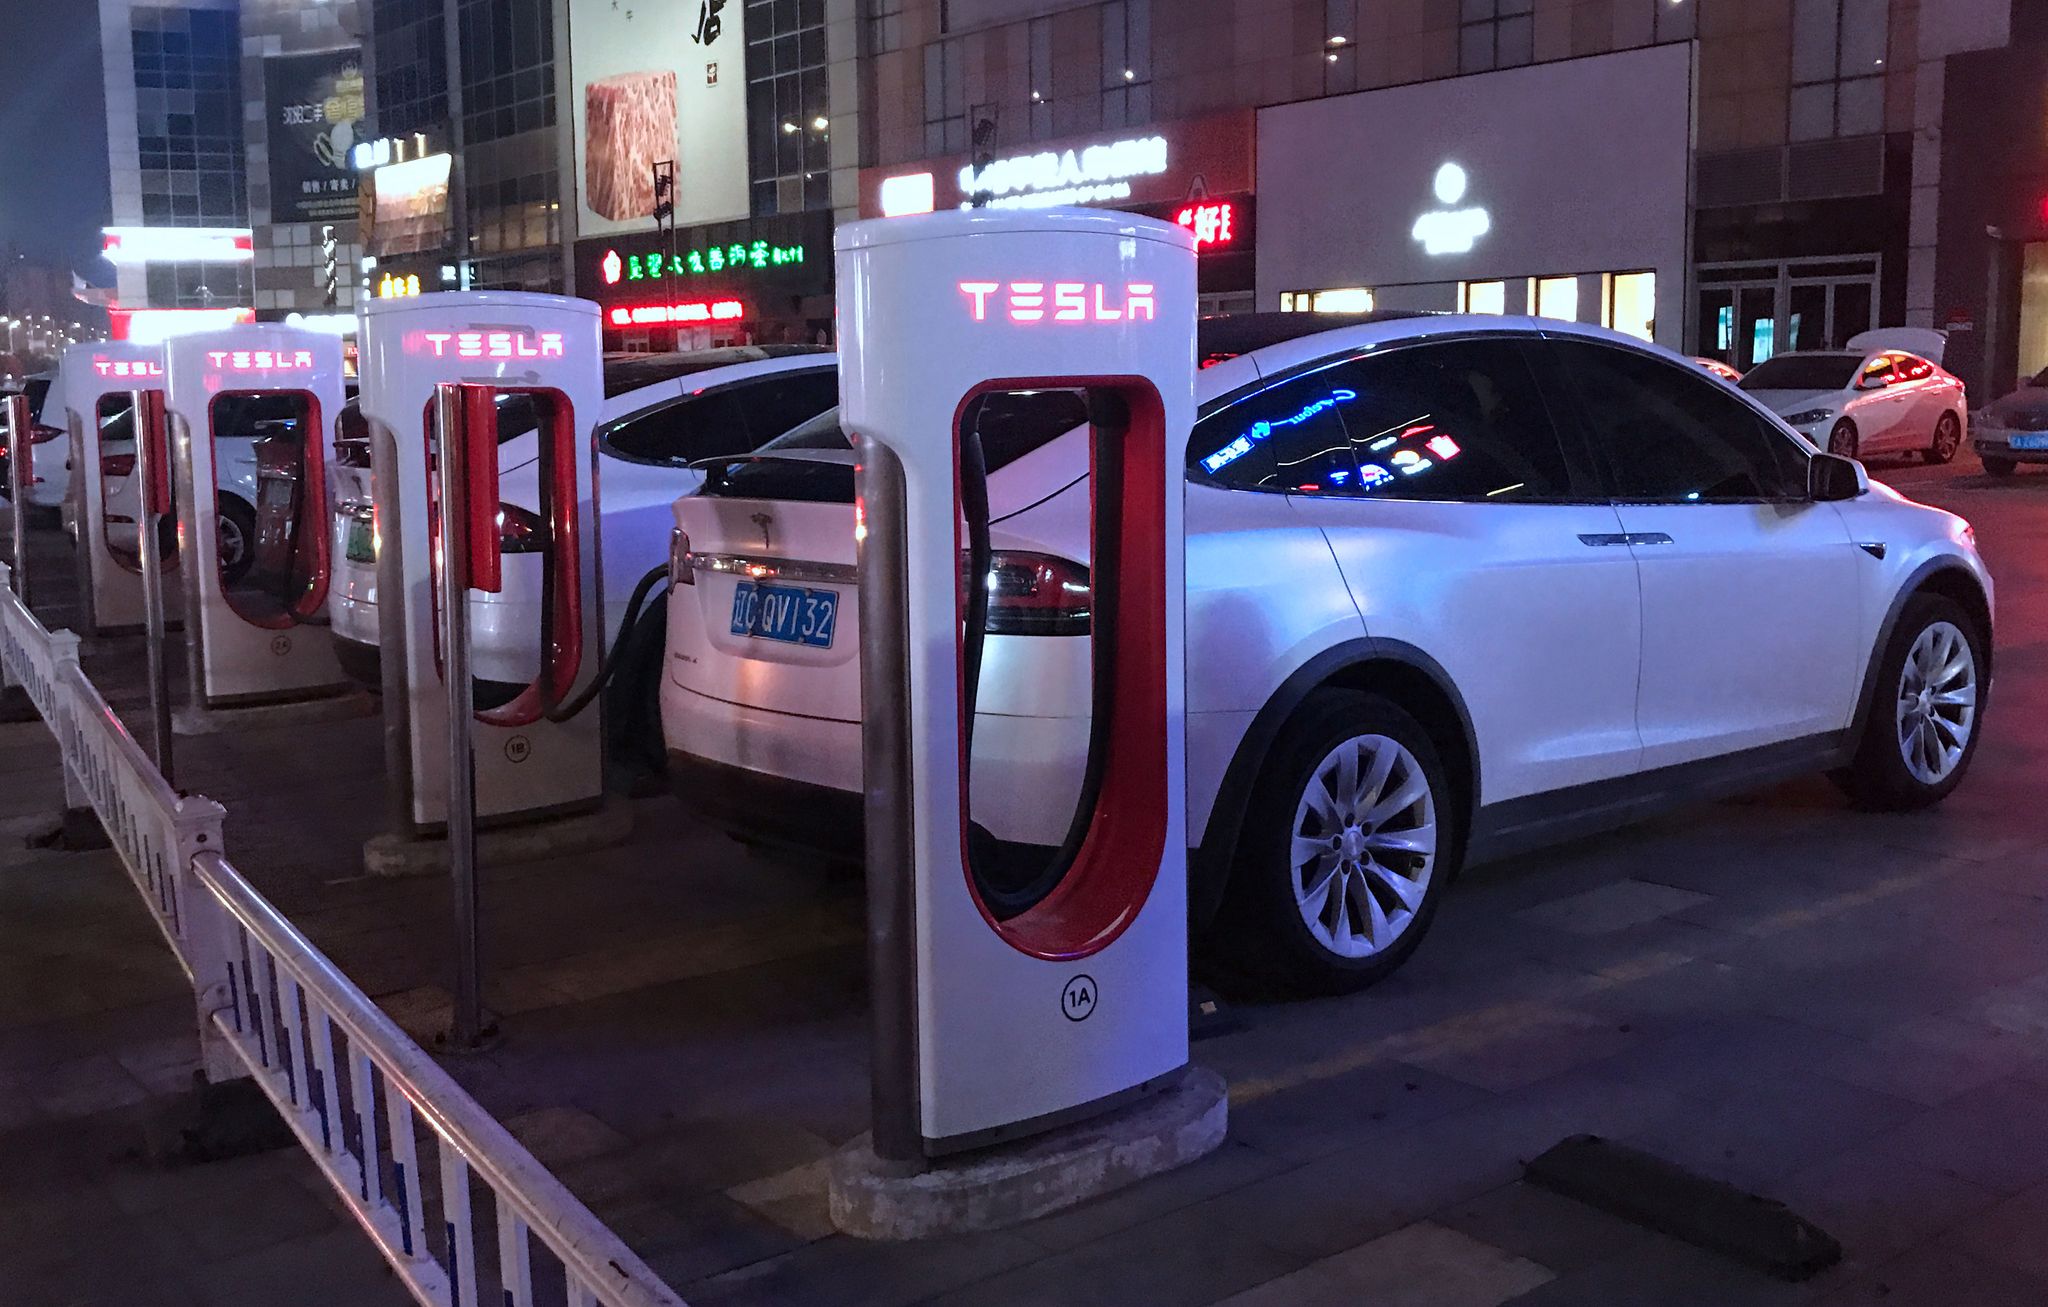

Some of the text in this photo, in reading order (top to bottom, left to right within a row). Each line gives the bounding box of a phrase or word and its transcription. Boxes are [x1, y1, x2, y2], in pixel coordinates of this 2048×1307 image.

[959, 282, 1154, 320] TESLA
[425, 333, 564, 357] TESLA
[208, 351, 313, 369] TESLA
[1069, 987, 1091, 1008] 1A
